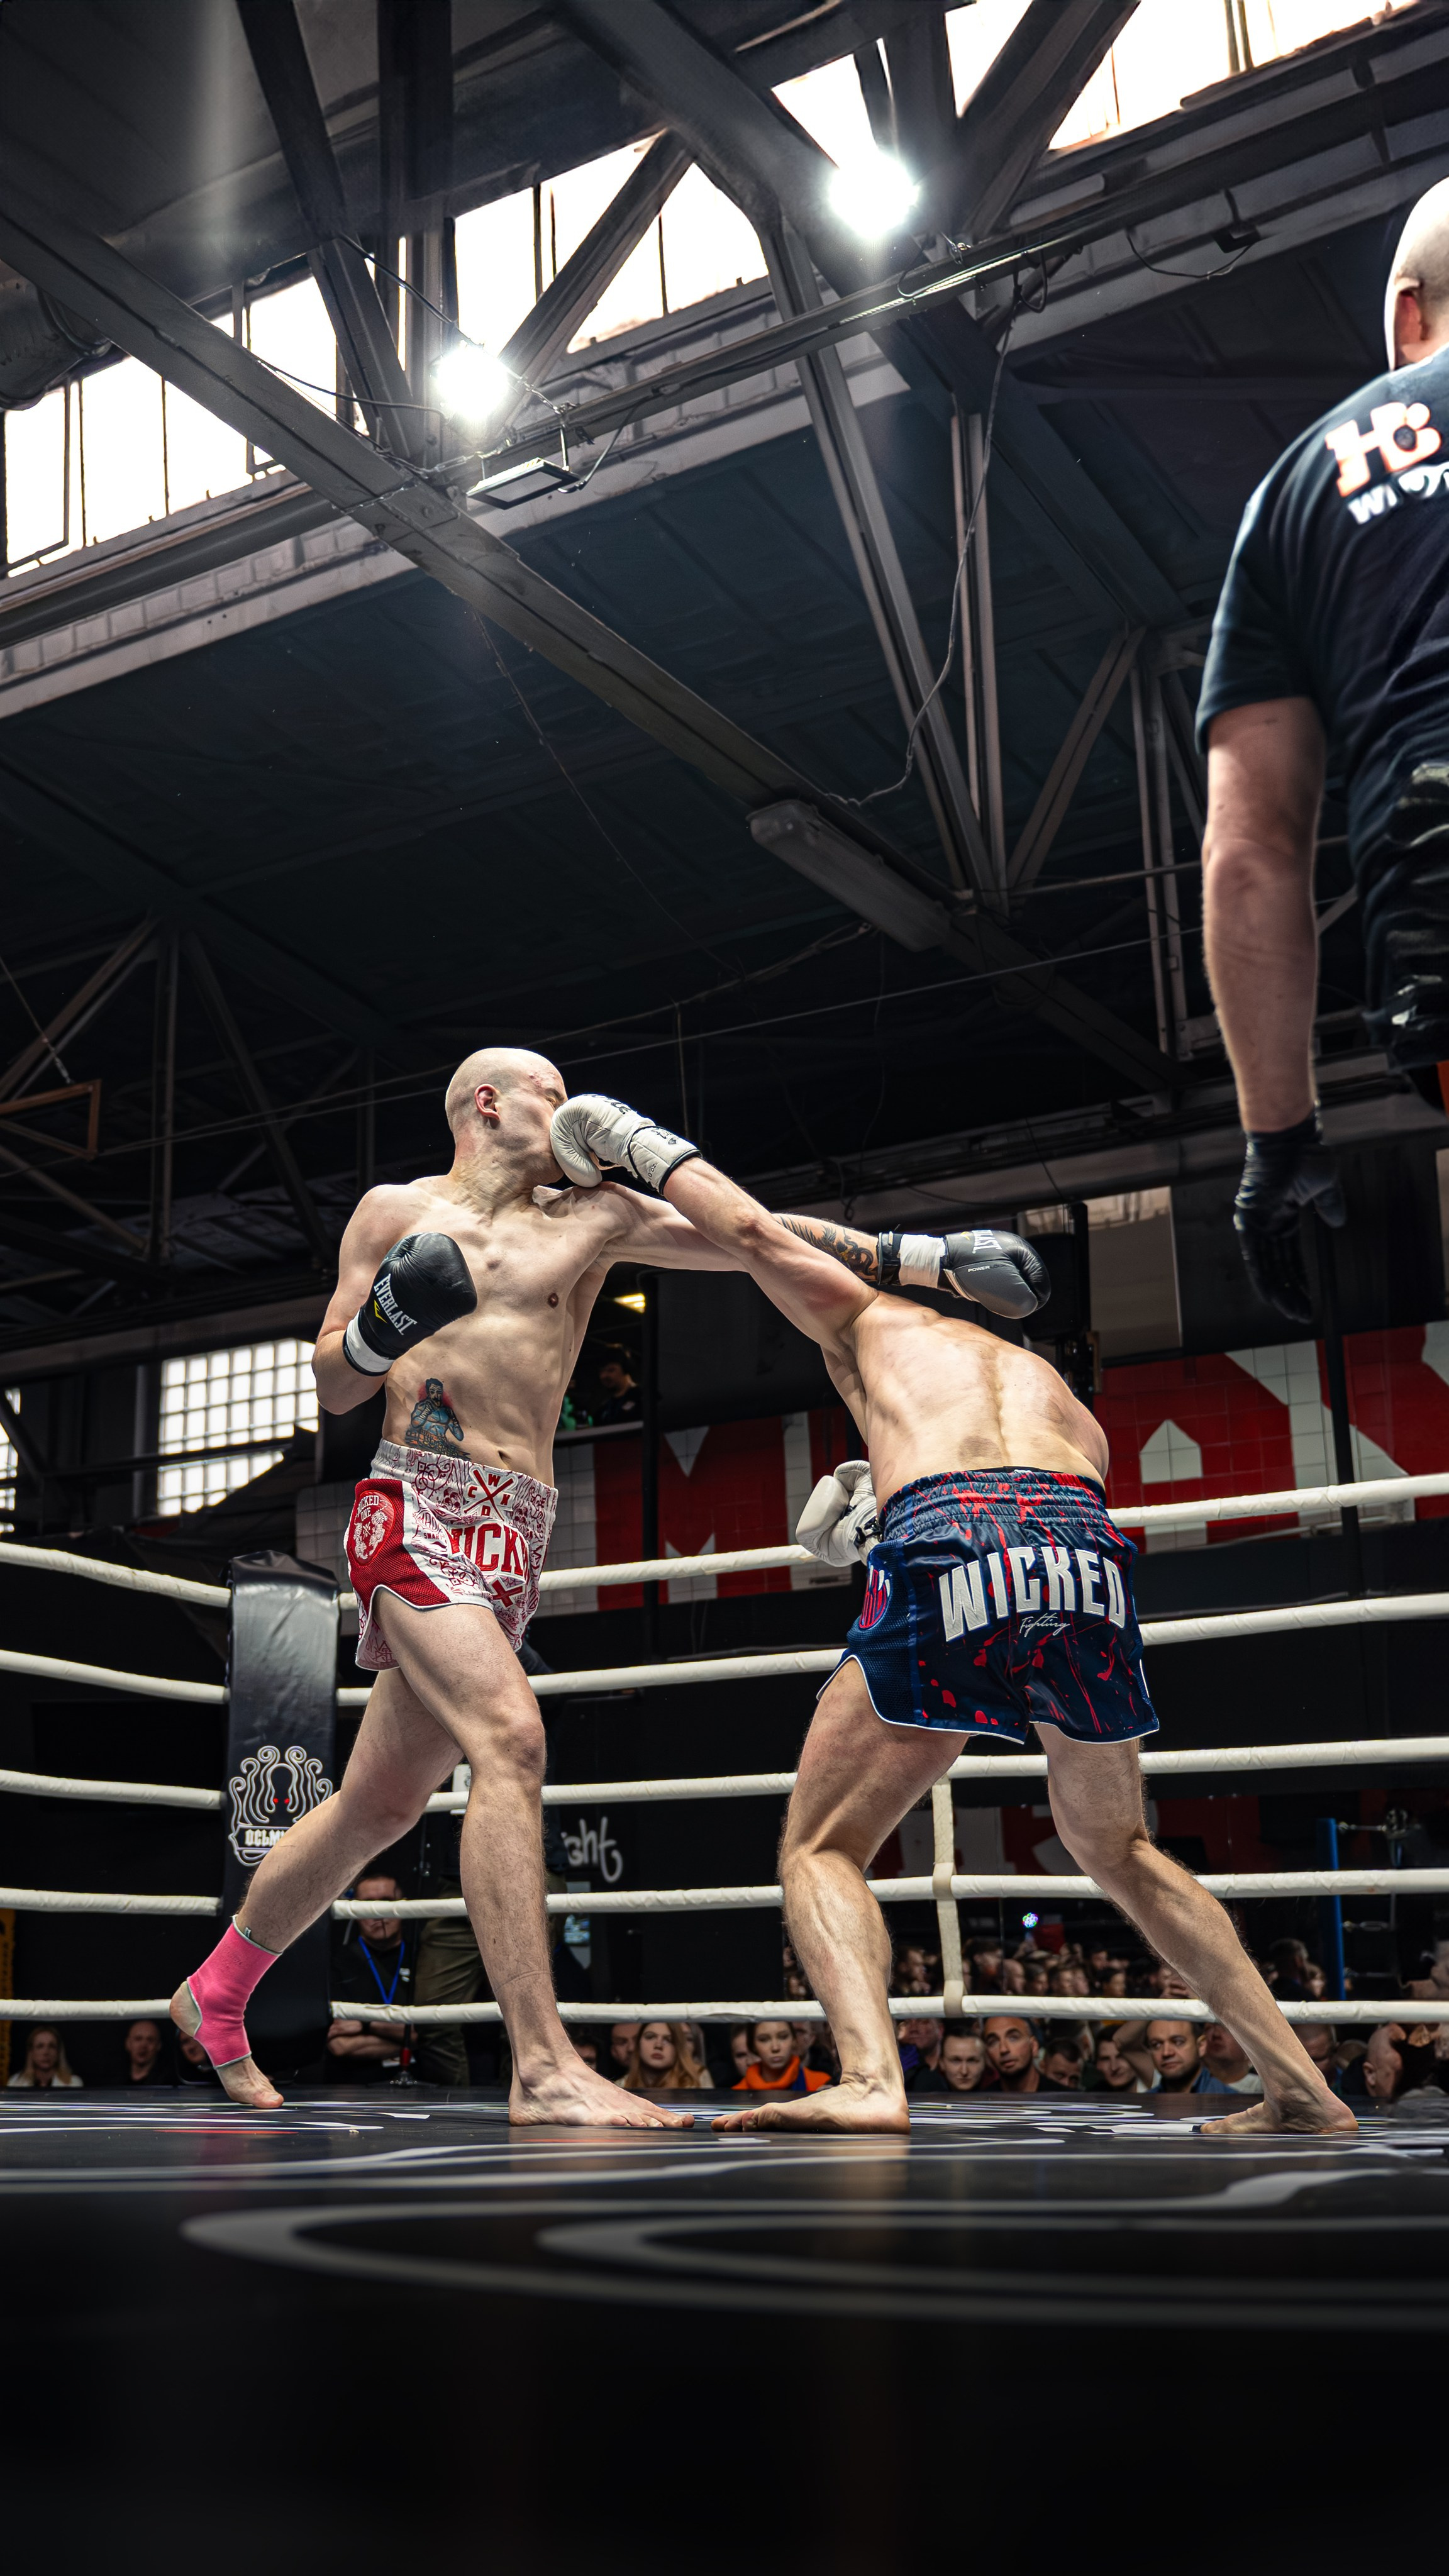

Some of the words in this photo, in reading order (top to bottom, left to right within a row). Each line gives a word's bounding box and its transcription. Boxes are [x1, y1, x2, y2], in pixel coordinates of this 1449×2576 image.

[374, 1273, 418, 1335] EVERLAST
[360, 1507, 371, 1521] ONE
[939, 1546, 1126, 1642] WICKED
[1019, 1612, 1070, 1637] Fighting
